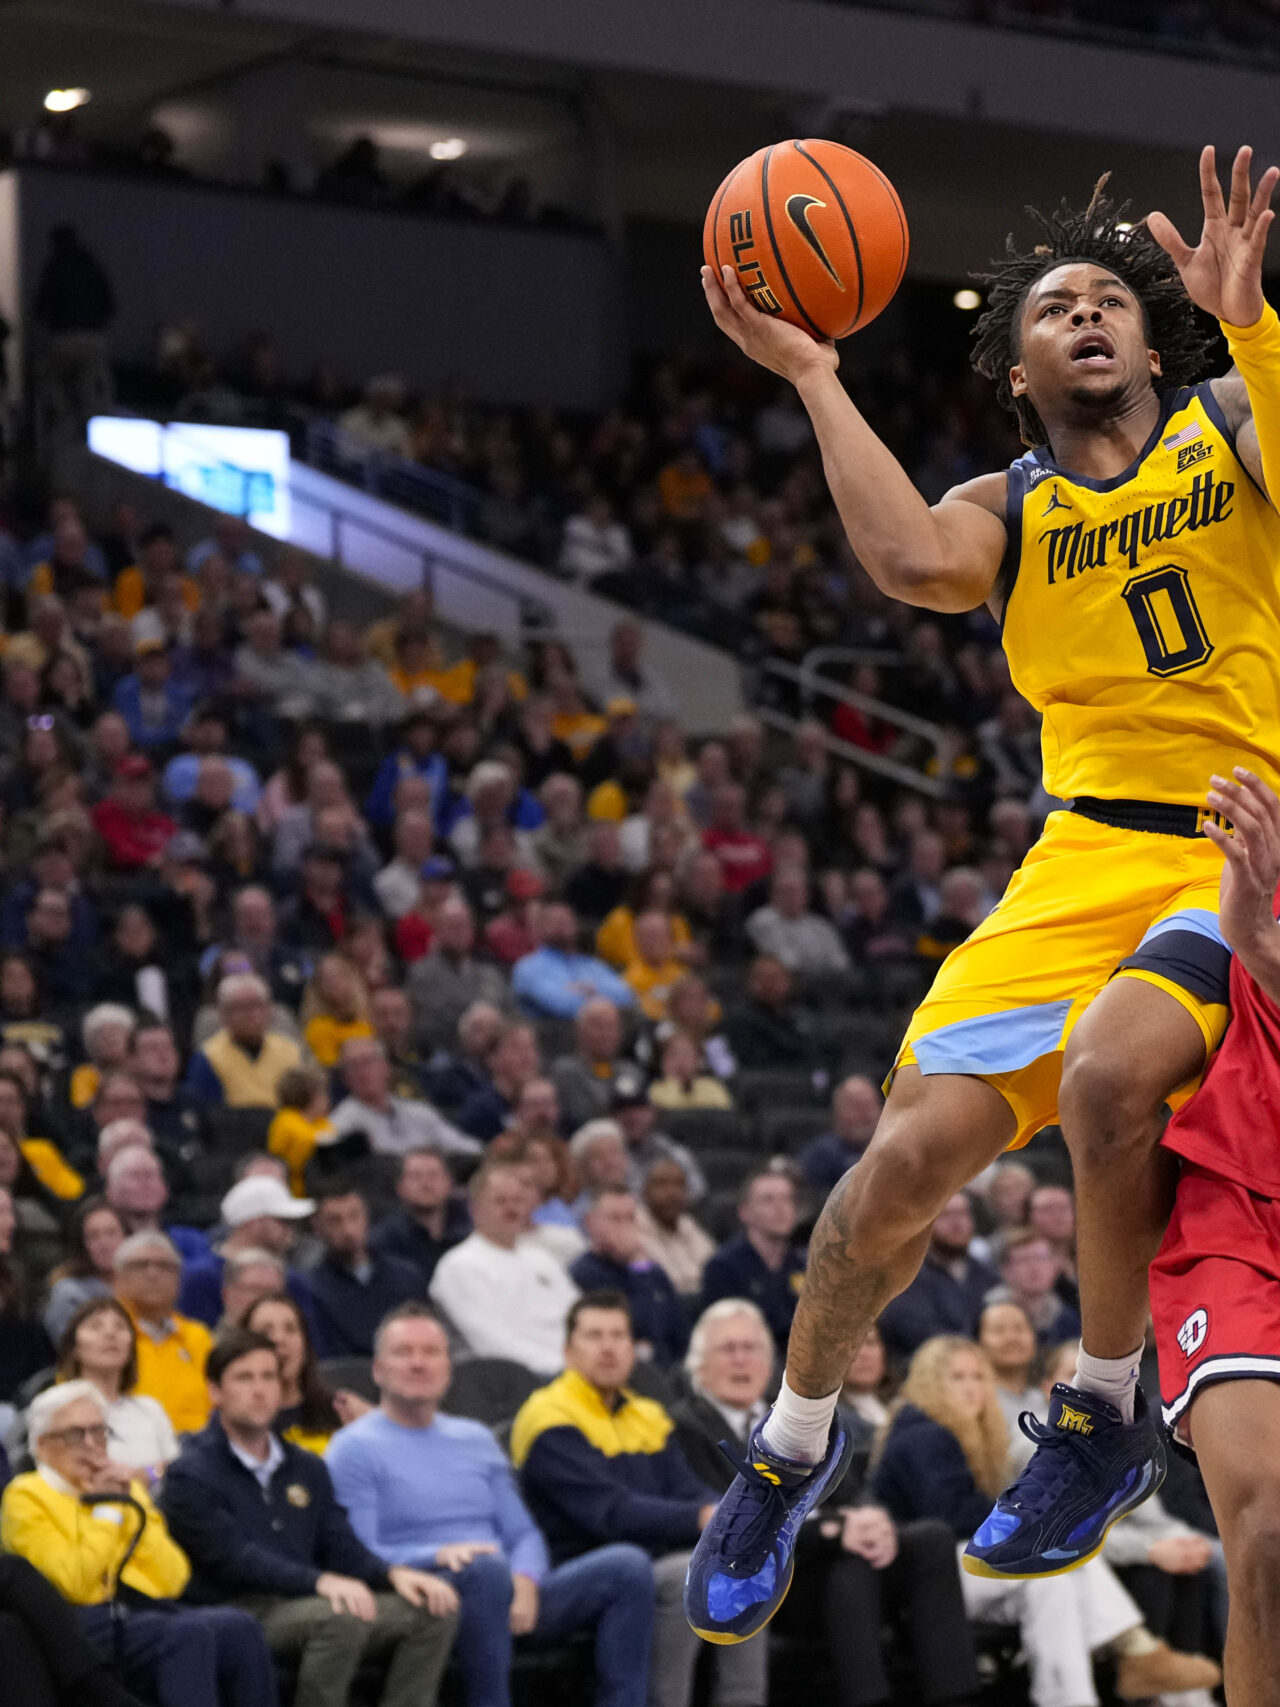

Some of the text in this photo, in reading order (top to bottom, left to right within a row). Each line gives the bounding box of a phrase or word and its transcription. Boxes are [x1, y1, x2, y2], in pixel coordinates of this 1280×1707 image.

[730, 209, 783, 314] ELITE
[1177, 445, 1213, 469] EAST
[1178, 440, 1203, 459] BIG
[1038, 469, 1234, 585] Marquette
[1121, 563, 1215, 678] 0
